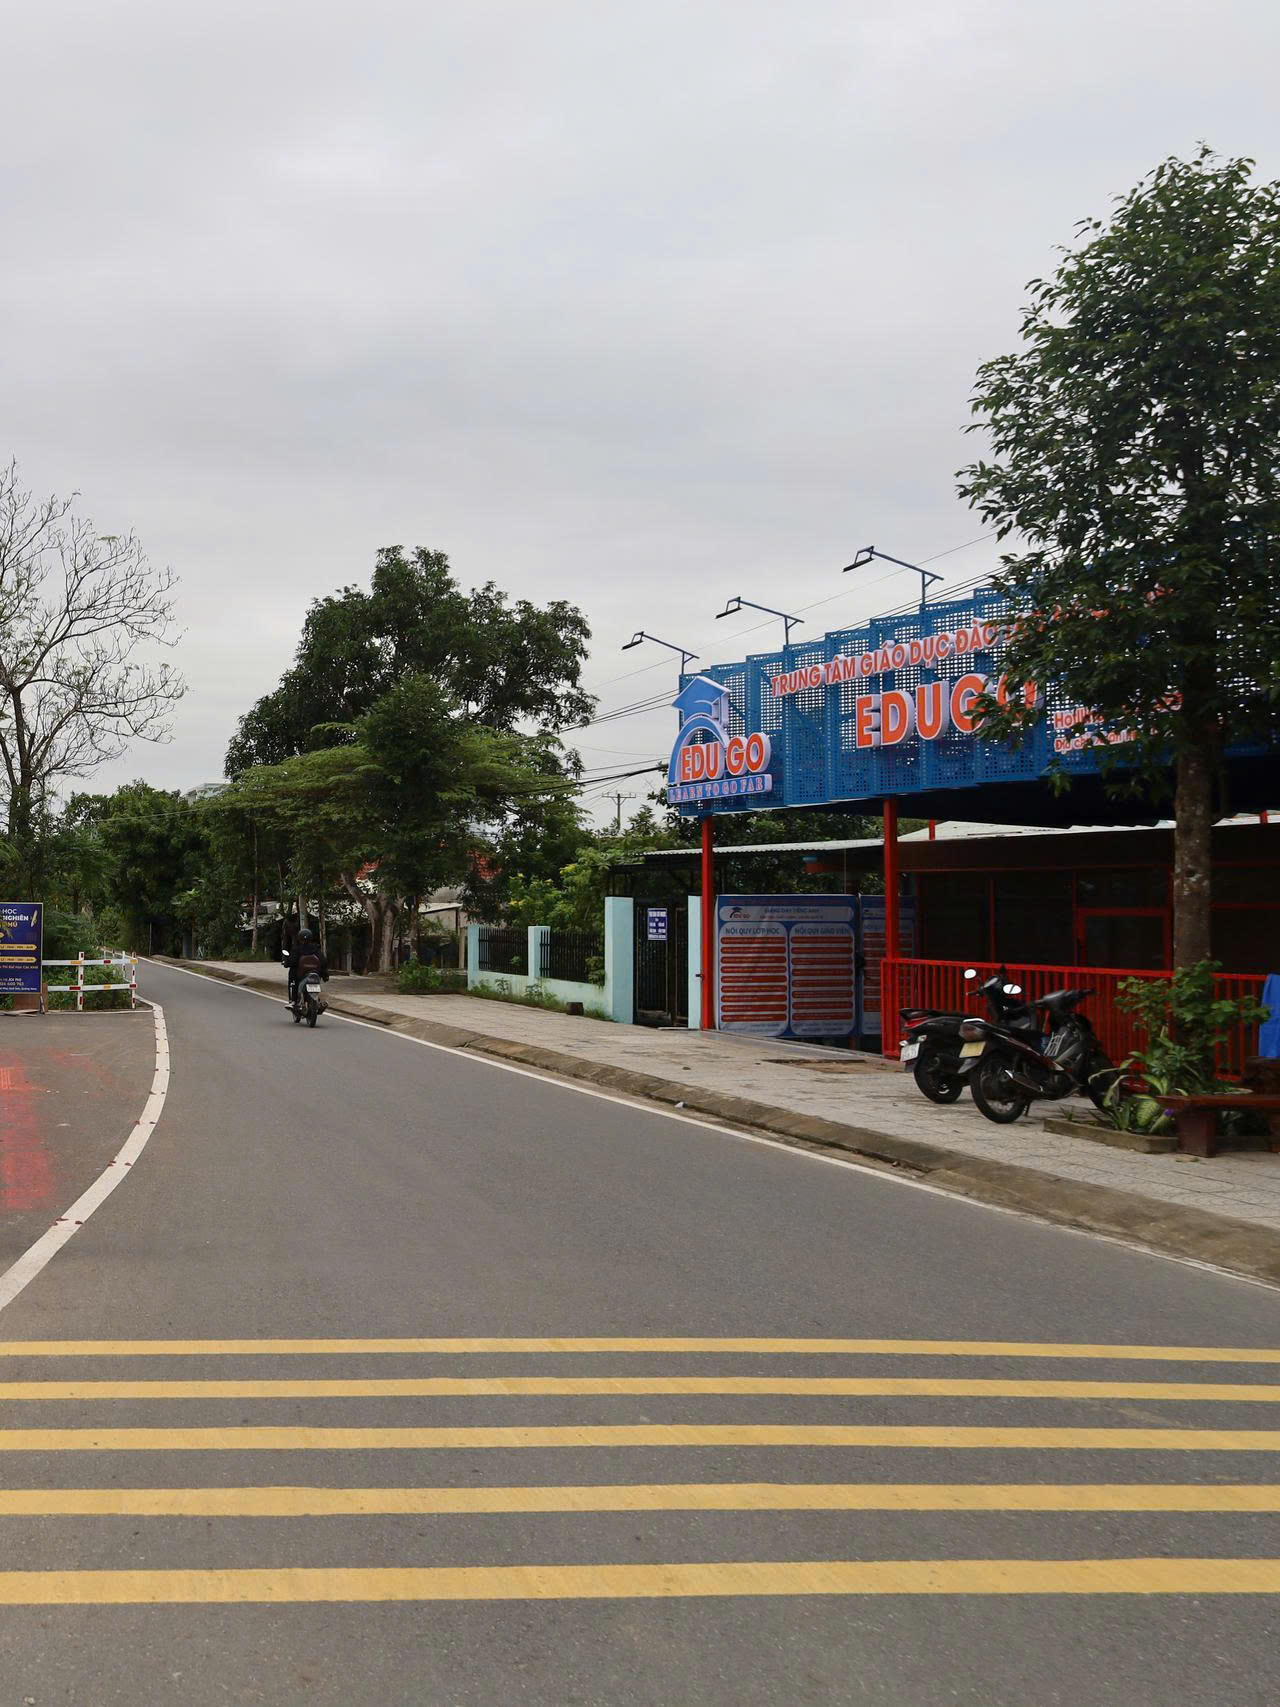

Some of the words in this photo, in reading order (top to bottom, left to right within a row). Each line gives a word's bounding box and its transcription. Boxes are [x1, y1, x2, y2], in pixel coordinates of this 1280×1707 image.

[771, 665, 821, 697] TRUNG
[824, 656, 856, 685] TÂM
[860, 640, 906, 677] GIÁO
[909, 633, 950, 667] DỤC
[681, 741, 721, 781] EDU
[726, 733, 767, 775] GO
[668, 783, 703, 802] LEARN
[705, 783, 720, 798] TO
[721, 780, 738, 796] GO
[739, 776, 764, 794] FAR
